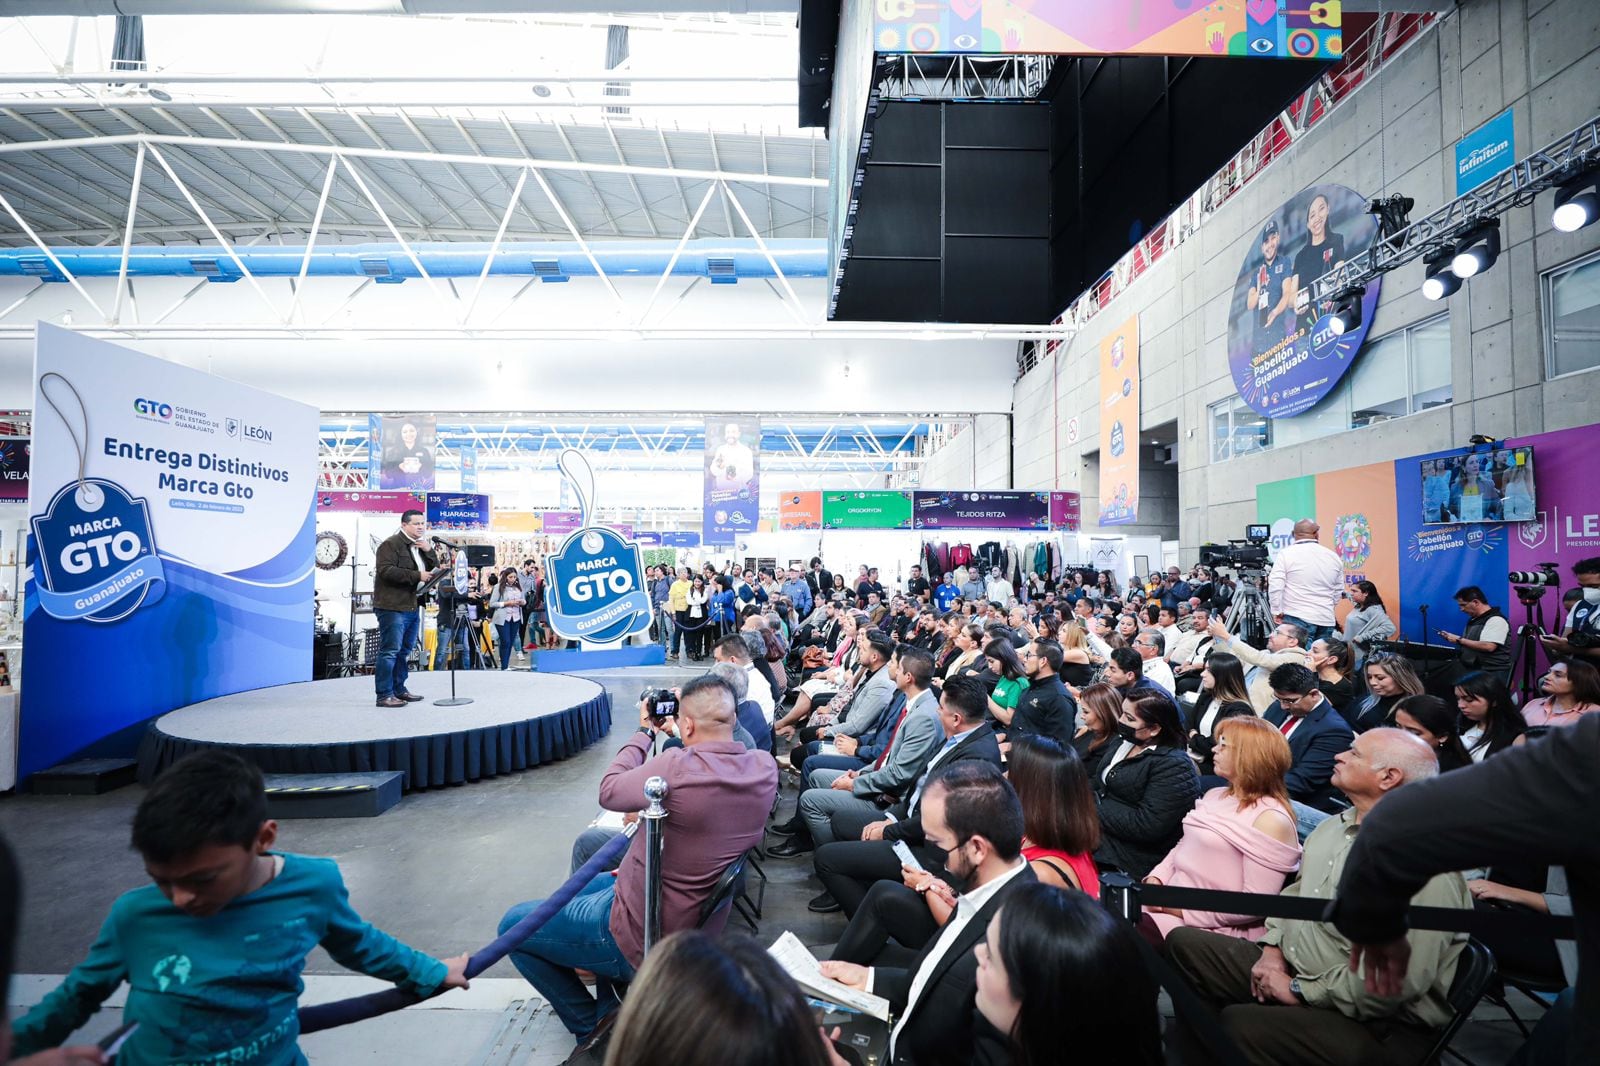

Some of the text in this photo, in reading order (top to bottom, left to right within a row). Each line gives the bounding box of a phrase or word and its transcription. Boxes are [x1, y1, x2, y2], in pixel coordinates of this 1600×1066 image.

[1459, 140, 1509, 174] infinitum
[1253, 328, 1305, 366] Bienvenidos a
[1254, 347, 1293, 377] Pabellón
[1255, 350, 1308, 388] Guanajuato
[133, 398, 173, 420] GTO
[175, 406, 207, 418] GOBIERNO
[175, 413, 187, 421] DEL
[188, 416, 211, 426] ESTADO
[175, 421, 215, 434] GUANAJUATO
[244, 425, 273, 442] LEÓN
[104, 437, 289, 483] Entrega Distintivos
[158, 472, 254, 500] Marca Gto
[69, 516, 122, 537] MARCA
[1417, 526, 1457, 538] Bienvenidos
[1467, 530, 1484, 541] GTO
[1418, 534, 1452, 546] Pabellón
[1419, 540, 1464, 553] Guanajuato
[60, 530, 141, 574] GTO
[576, 556, 618, 572] MARCA
[75, 568, 144, 610] Guanajuato
[567, 568, 633, 602] GTO
[576, 601, 633, 630] Guanajuato
